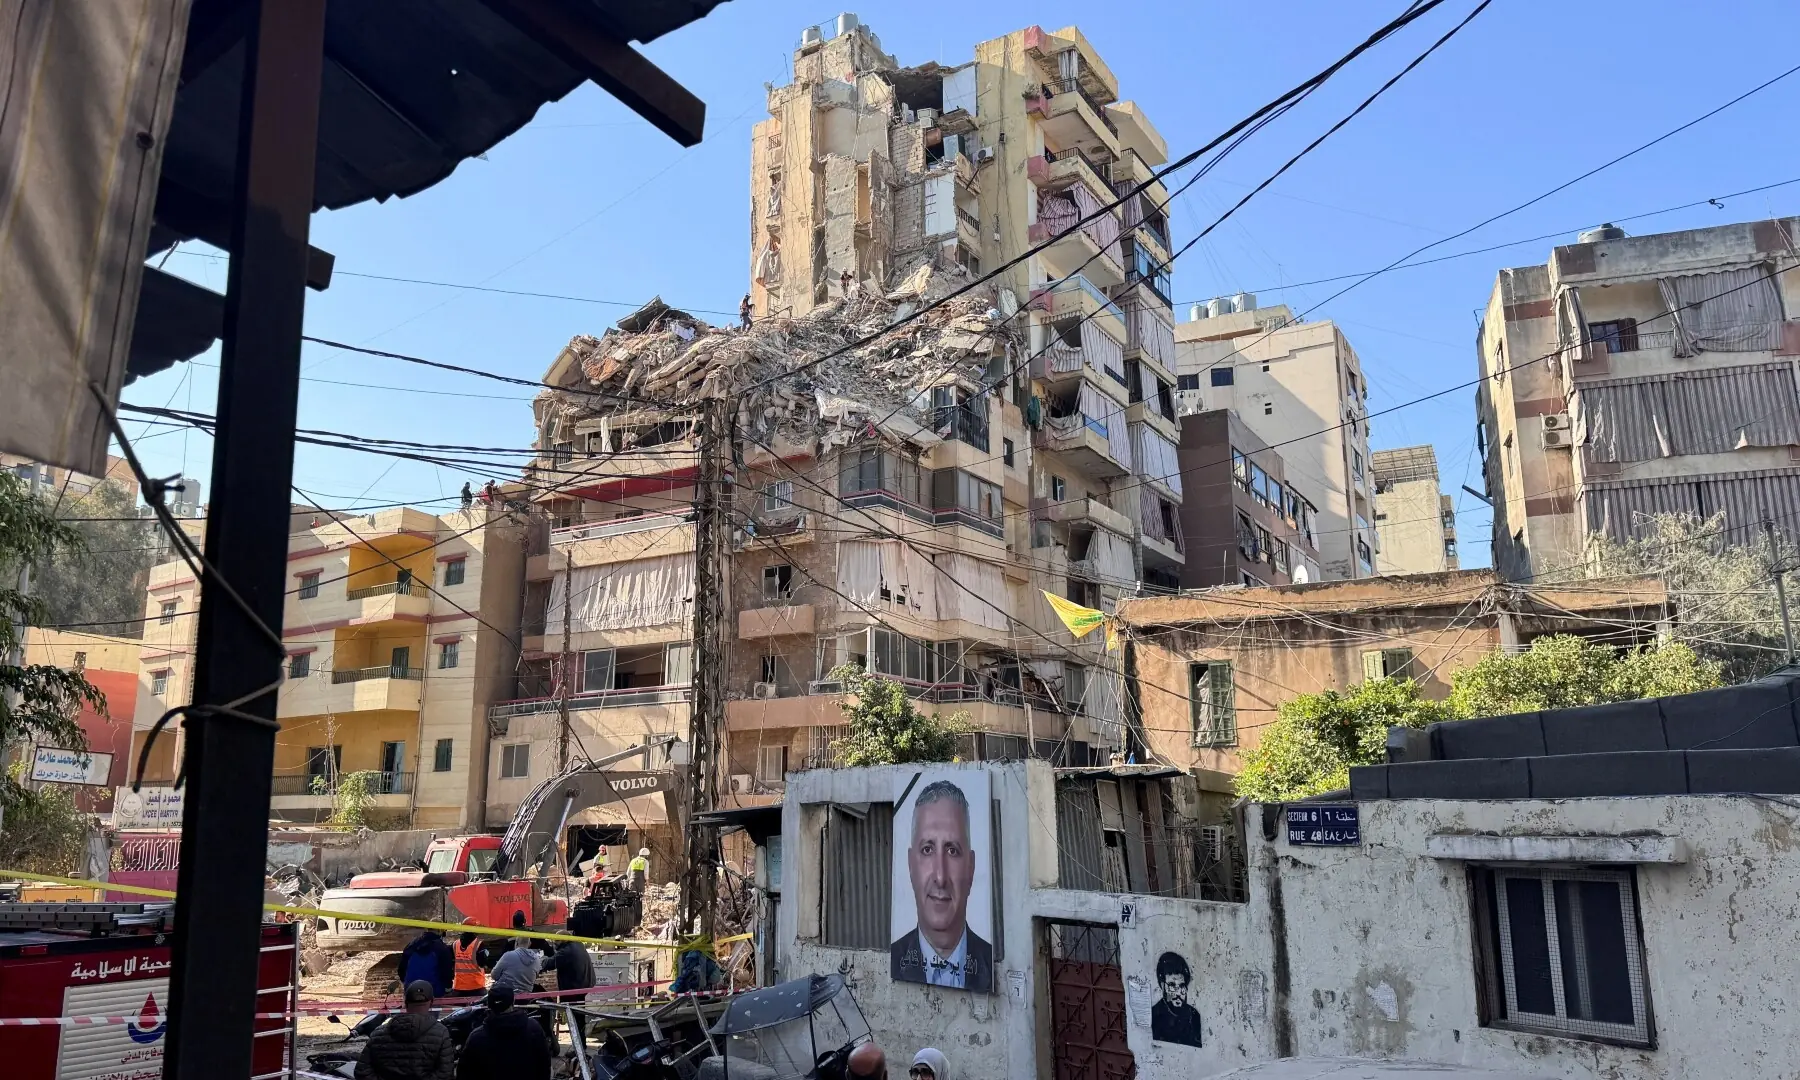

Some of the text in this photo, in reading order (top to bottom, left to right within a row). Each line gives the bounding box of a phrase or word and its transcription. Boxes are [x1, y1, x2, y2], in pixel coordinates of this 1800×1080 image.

[36, 769, 53, 779] حريك
[54, 770, 69, 780] حارة
[610, 776, 658, 791] VOLVO
[1287, 811, 1317, 822] SECTEUR 6
[1325, 810, 1356, 822] منطقة ٦
[1290, 830, 1322, 841] RUE 48
[1324, 830, 1358, 842] شارع ٤٨
[494, 893, 531, 904] VOLVO
[342, 920, 376, 930] VOLVO
[929, 954, 960, 976] يرحمك
[144, 1047, 165, 1061] دفاع
